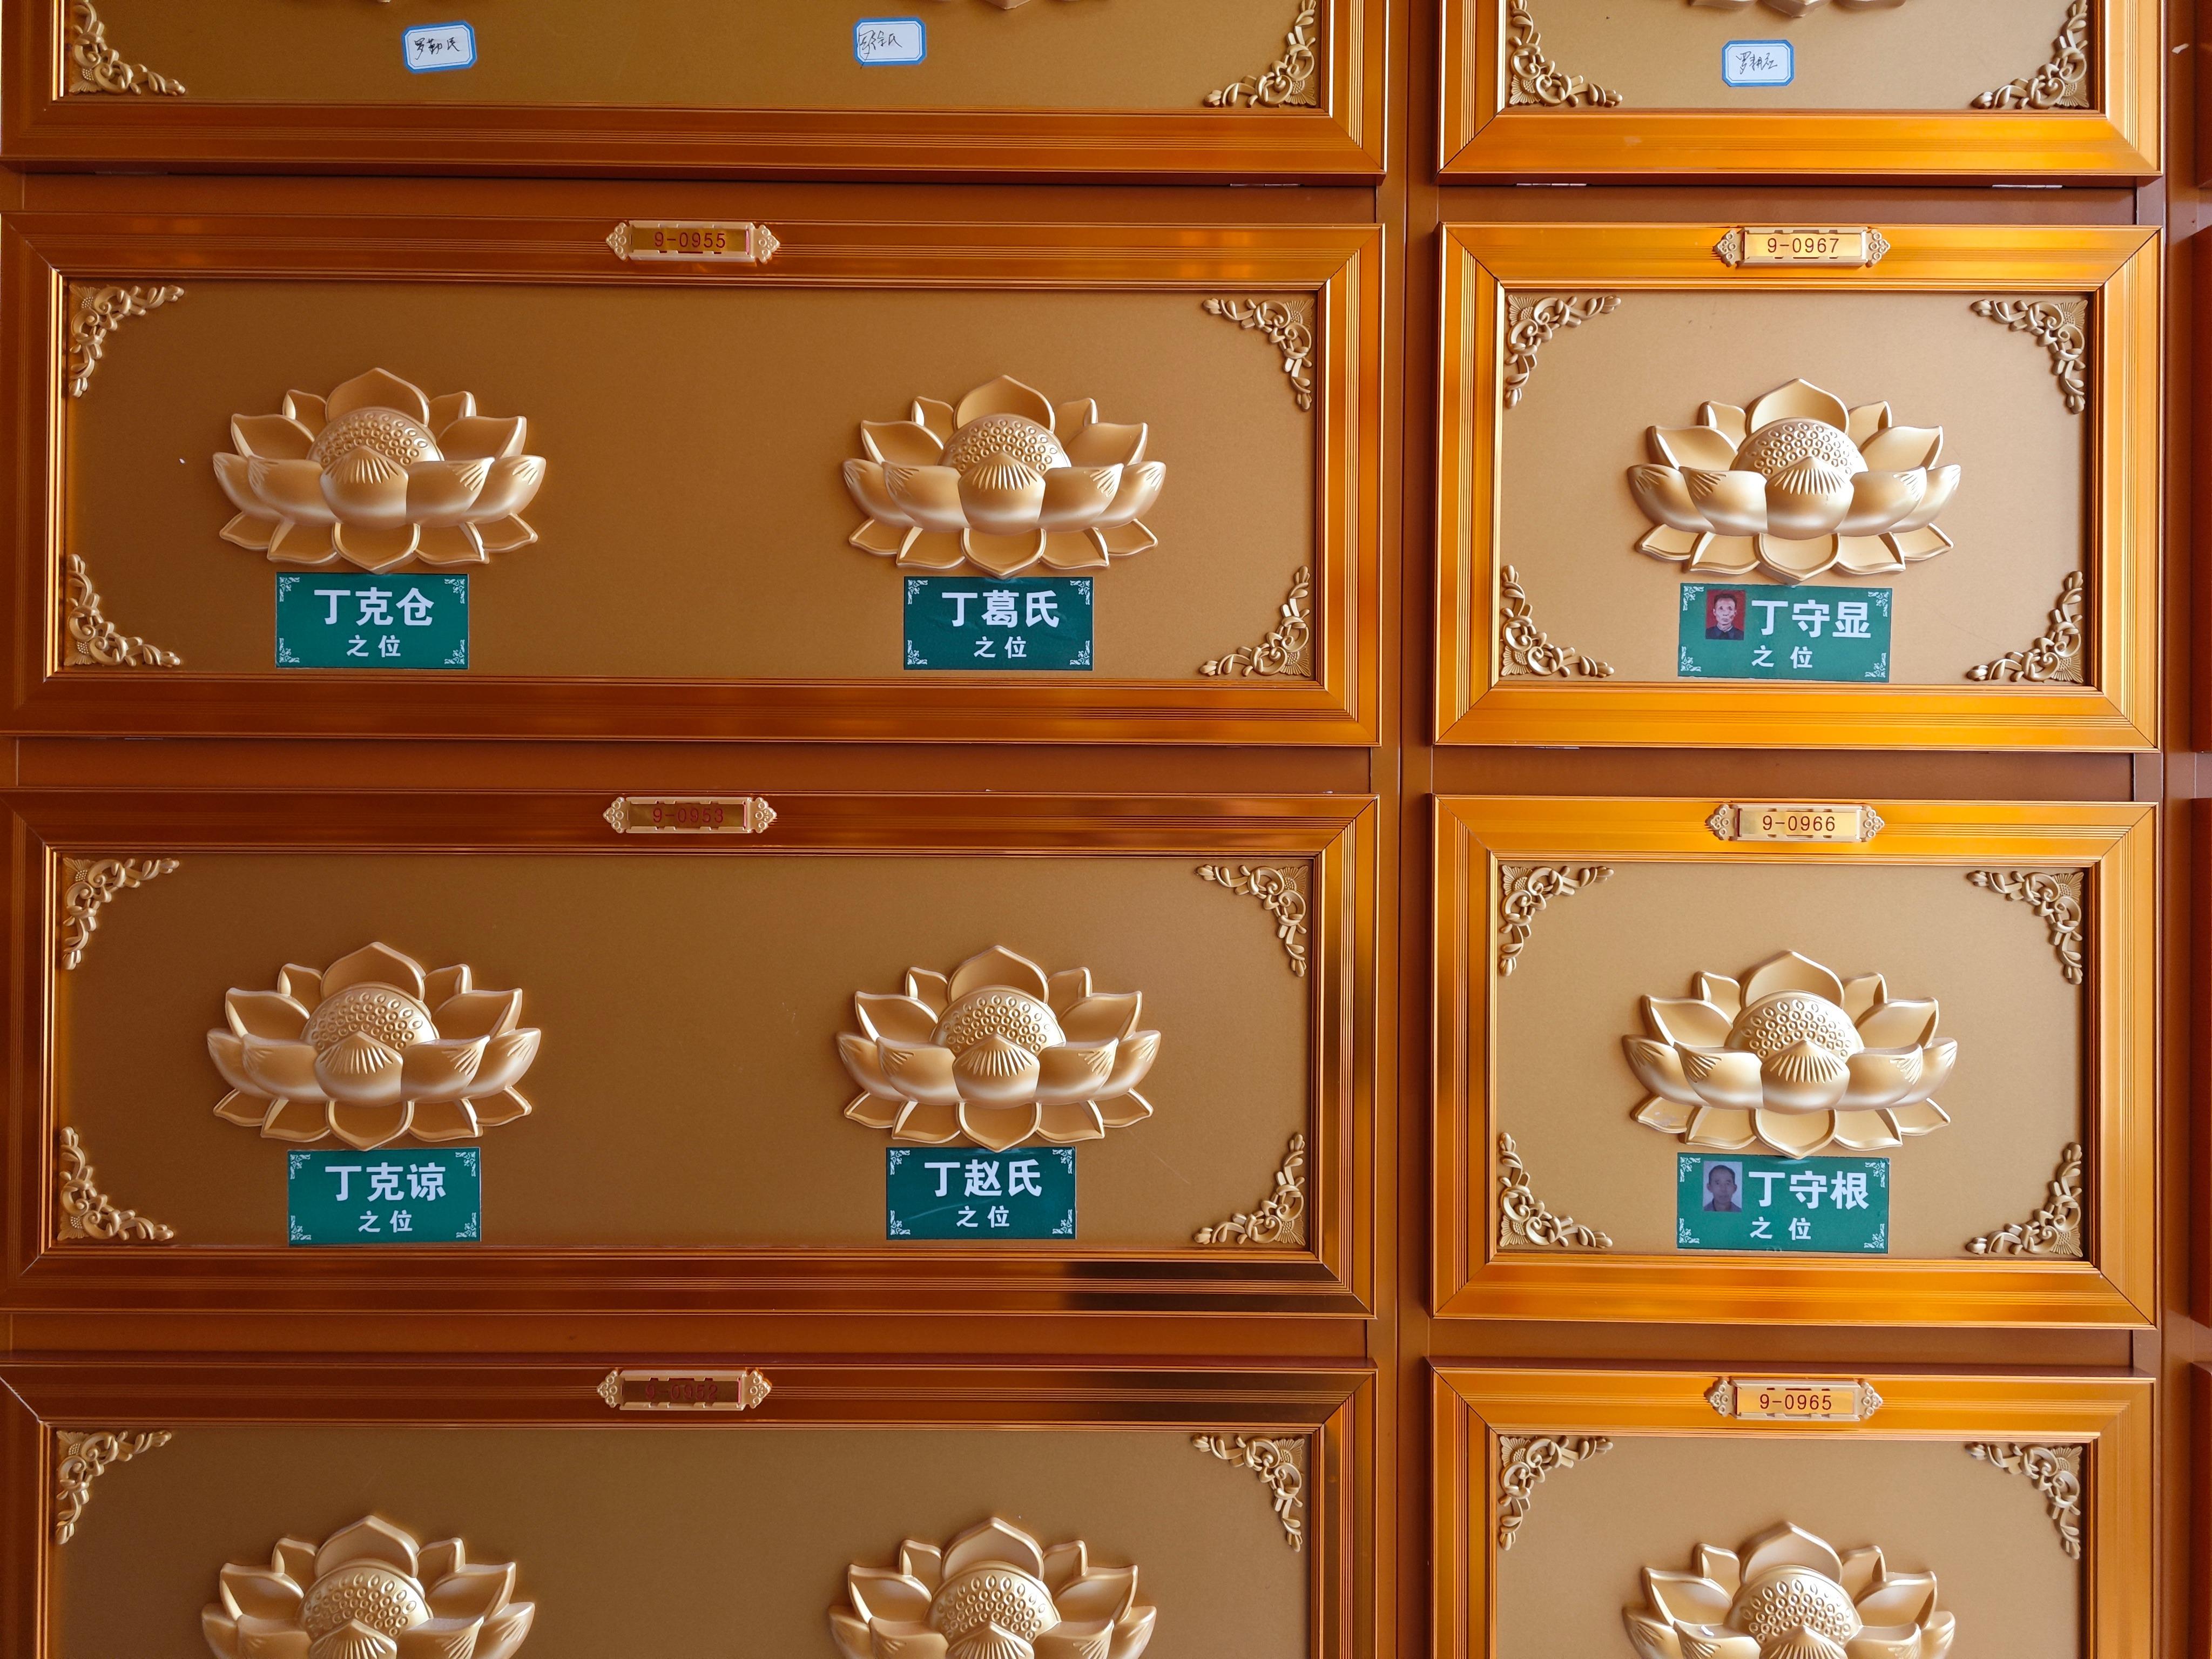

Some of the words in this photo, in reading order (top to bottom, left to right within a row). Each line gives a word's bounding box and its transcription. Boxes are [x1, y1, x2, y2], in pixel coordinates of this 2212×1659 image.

[654, 231, 726, 248] 9-0955
[1767, 237, 1839, 253] 9-0967
[314, 586, 435, 626] 丁克仓
[941, 589, 1060, 628] 丁葛氏
[1751, 599, 1872, 638] 丁守显
[346, 634, 401, 658] 之位
[973, 636, 1027, 659] 之位
[1751, 645, 1813, 669] 之位
[652, 807, 724, 823] 9-0953
[1762, 815, 1835, 832] 9-0966
[325, 1162, 447, 1202] 丁克谅
[924, 1158, 1043, 1197] 丁赵氏
[1748, 1170, 1870, 1210] 丁守根
[358, 1209, 413, 1233] 之位
[956, 1205, 1010, 1229] 之位
[1749, 1216, 1812, 1241] 之位
[1759, 1393, 1832, 1410] 9-0965
